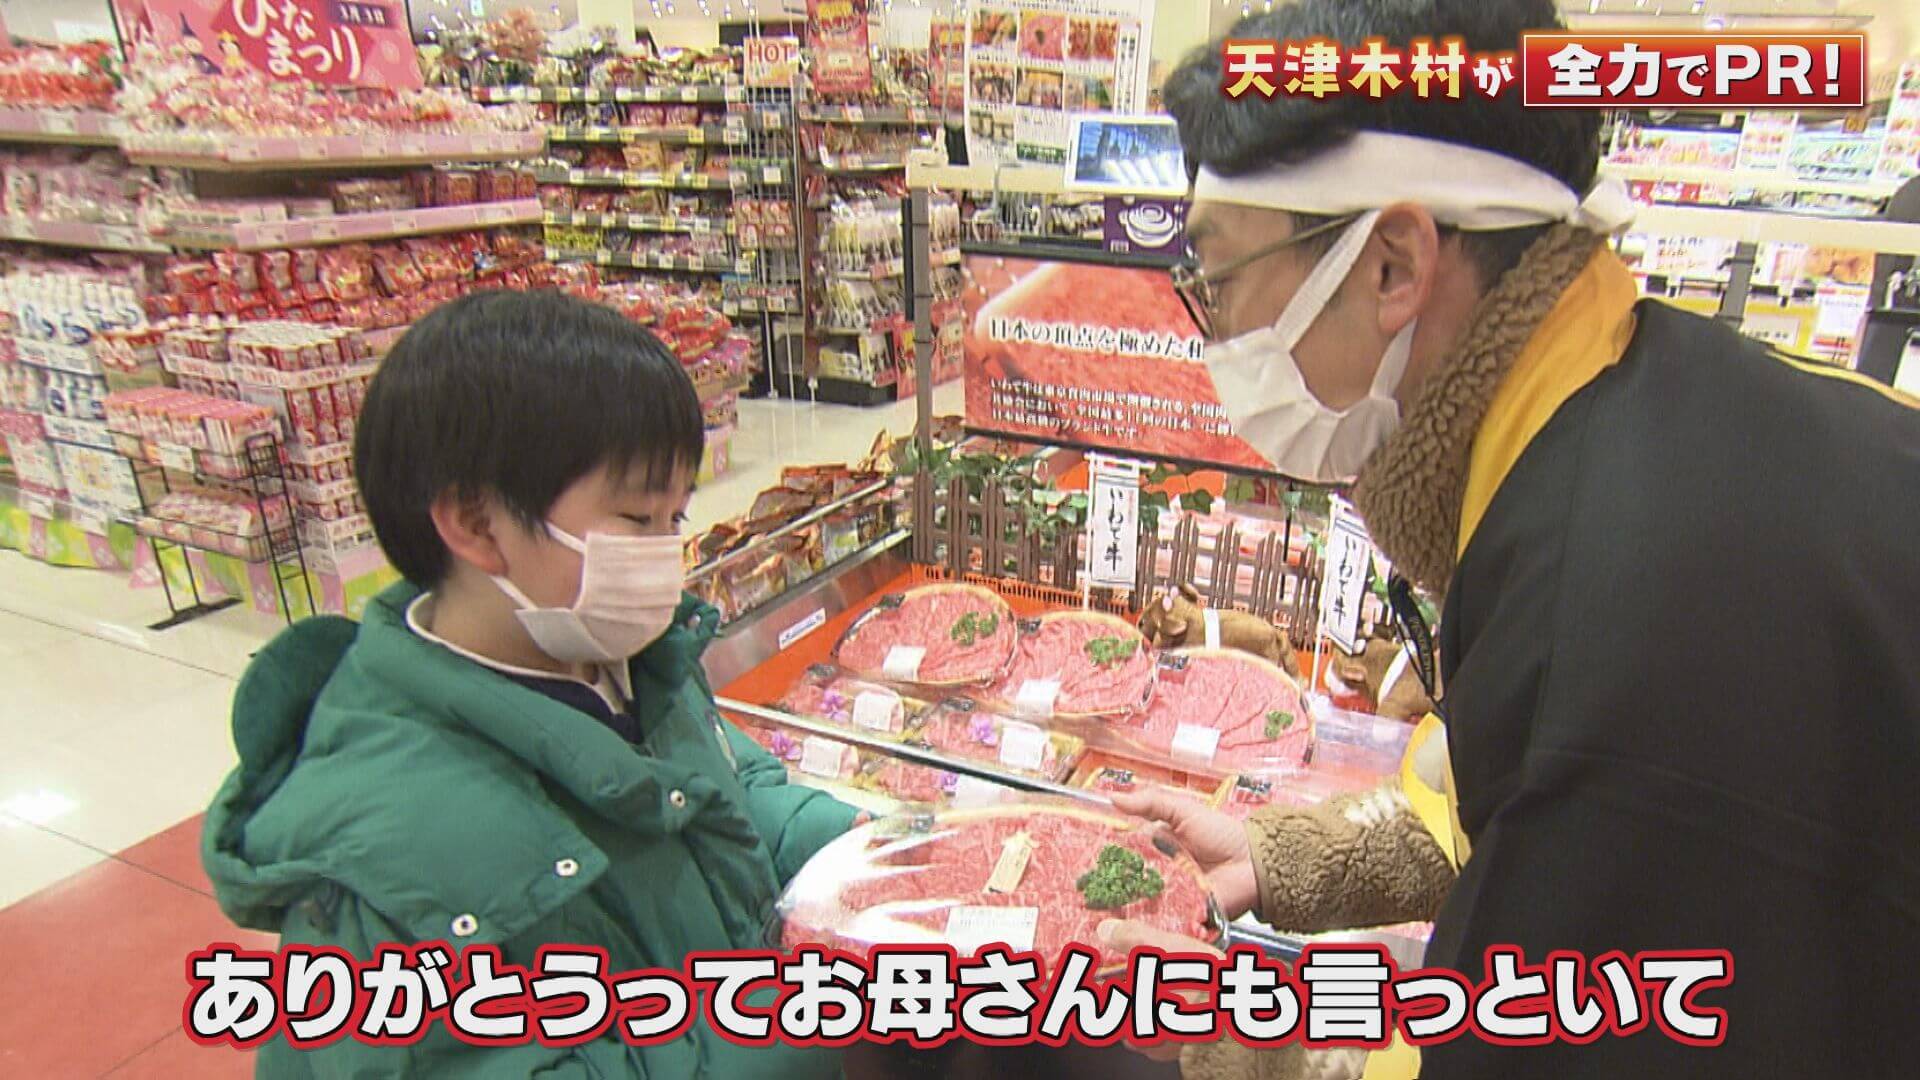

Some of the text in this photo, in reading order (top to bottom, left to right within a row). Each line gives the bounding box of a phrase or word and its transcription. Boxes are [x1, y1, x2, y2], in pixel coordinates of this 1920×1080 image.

[232, 0, 316, 41] ひな
[265, 26, 362, 80] まつり
[748, 41, 793, 63] HOT
[1104, 486, 1123, 572] いわて牛
[1332, 535, 1356, 627] いわて牛
